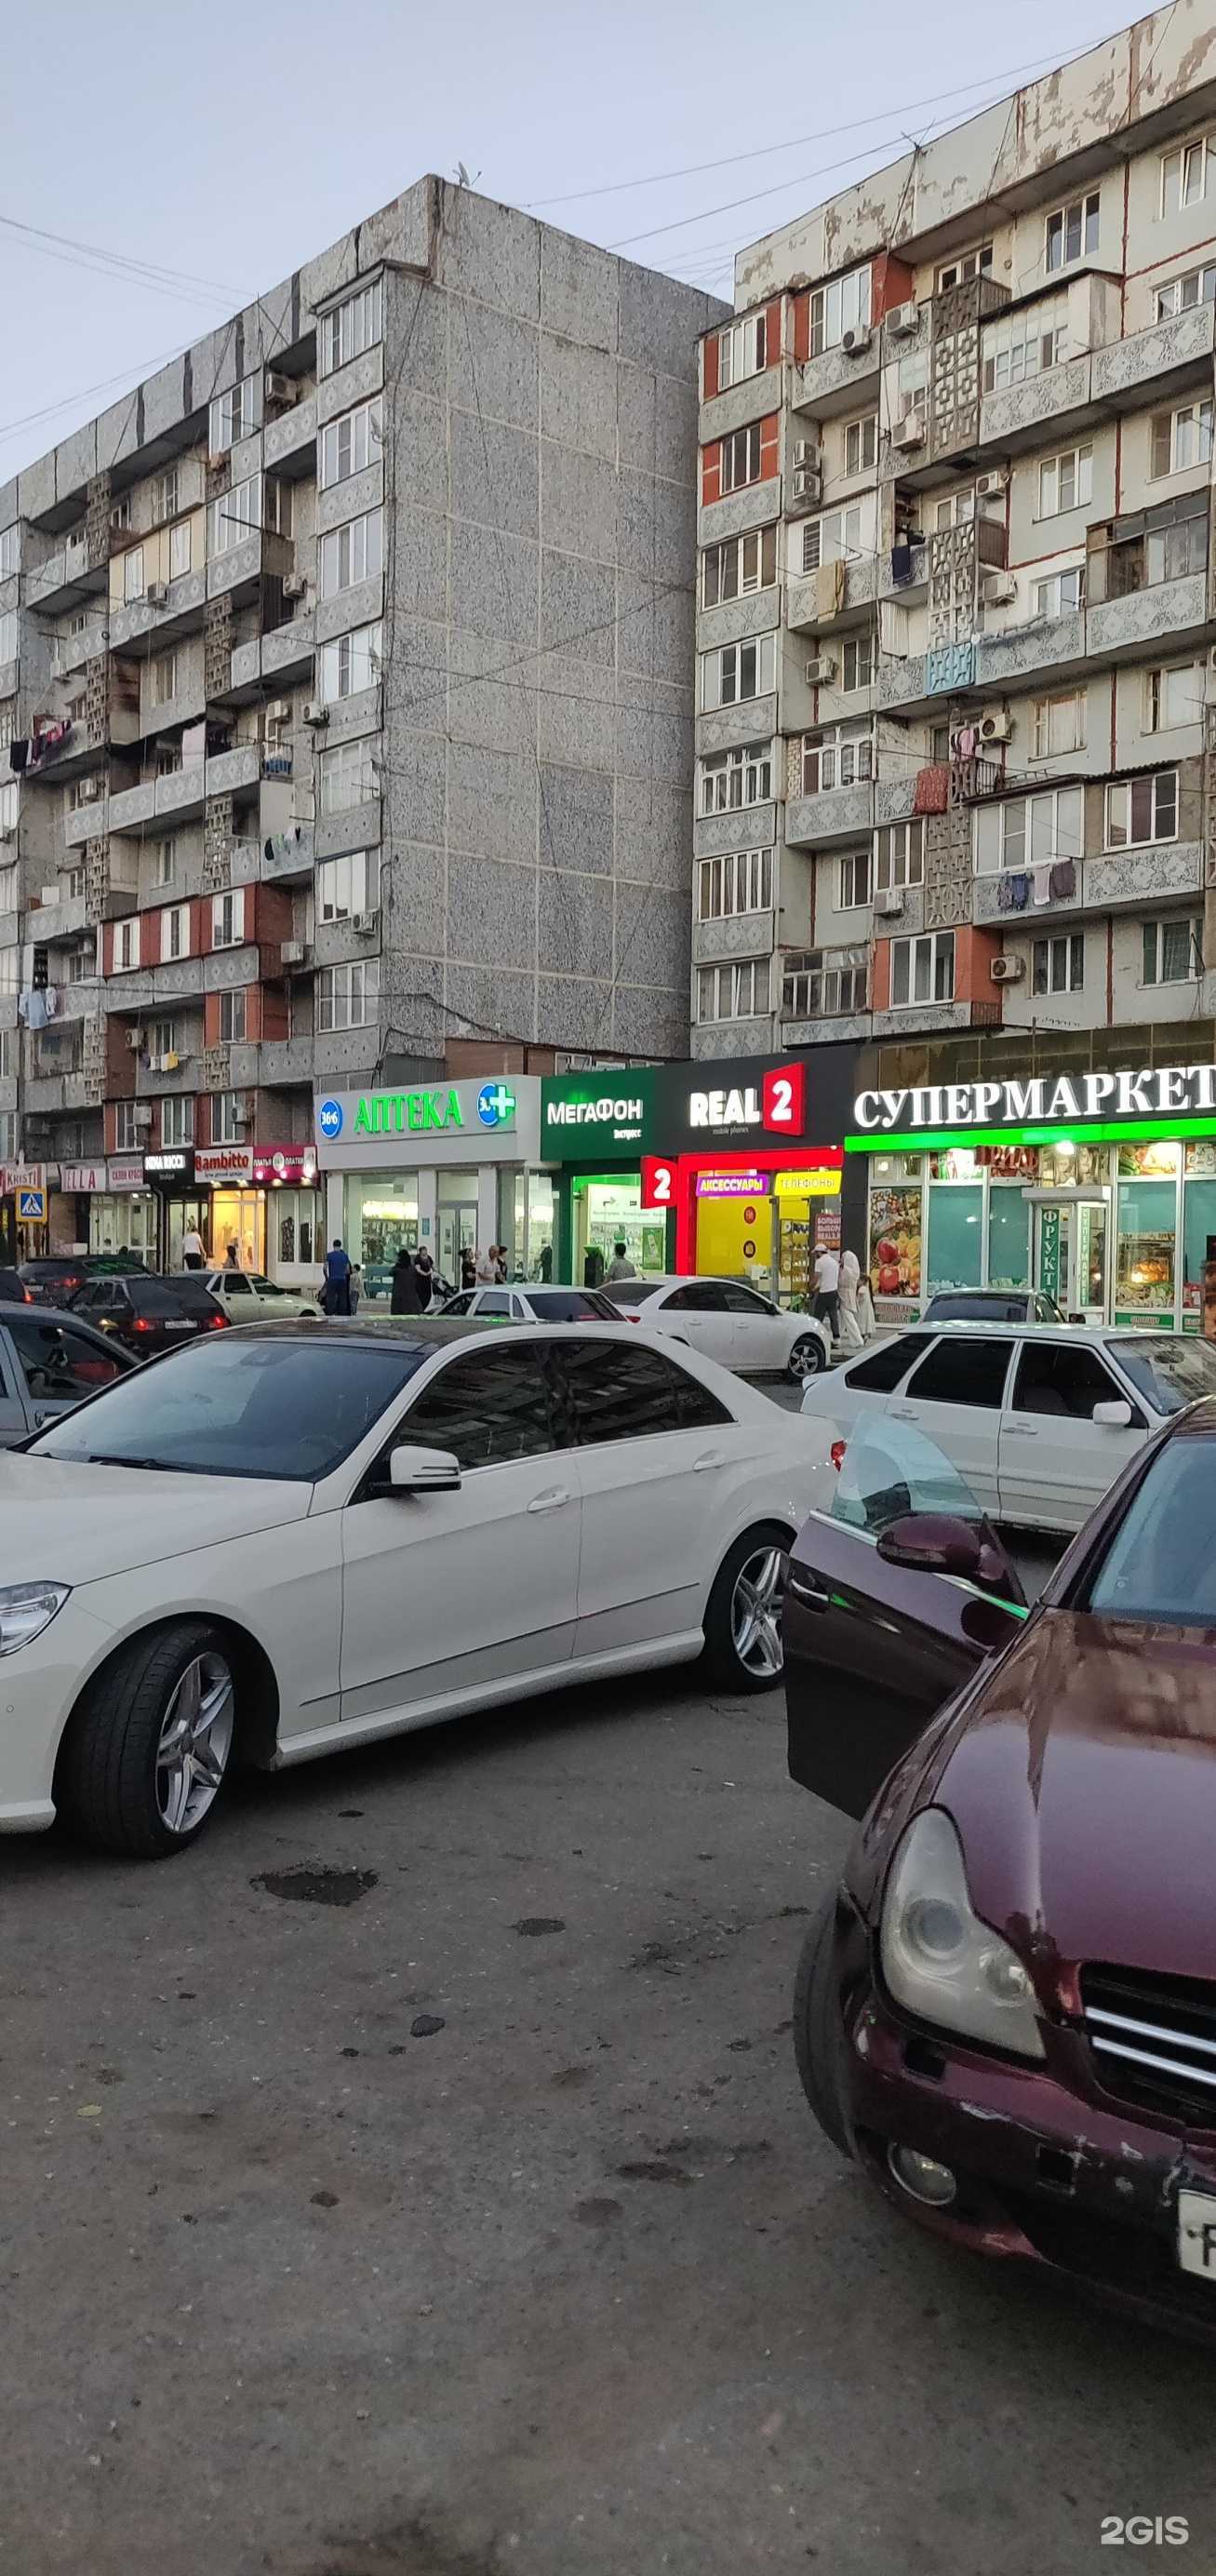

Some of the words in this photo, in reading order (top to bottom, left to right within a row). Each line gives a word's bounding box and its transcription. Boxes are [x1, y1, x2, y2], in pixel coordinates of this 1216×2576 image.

[354, 1089, 463, 1134] АПТЕКА
[689, 1087, 761, 1128] REAL
[770, 1080, 793, 1121] 2
[853, 1066, 1216, 1129] СУПЕРМАРКЕТ
[195, 1150, 248, 1171] Bambitto
[653, 1168, 671, 1200] 2
[700, 1178, 763, 1192] АКСЕССУАРЫ
[782, 1178, 835, 1188] ТЕЛЕФОНЫ
